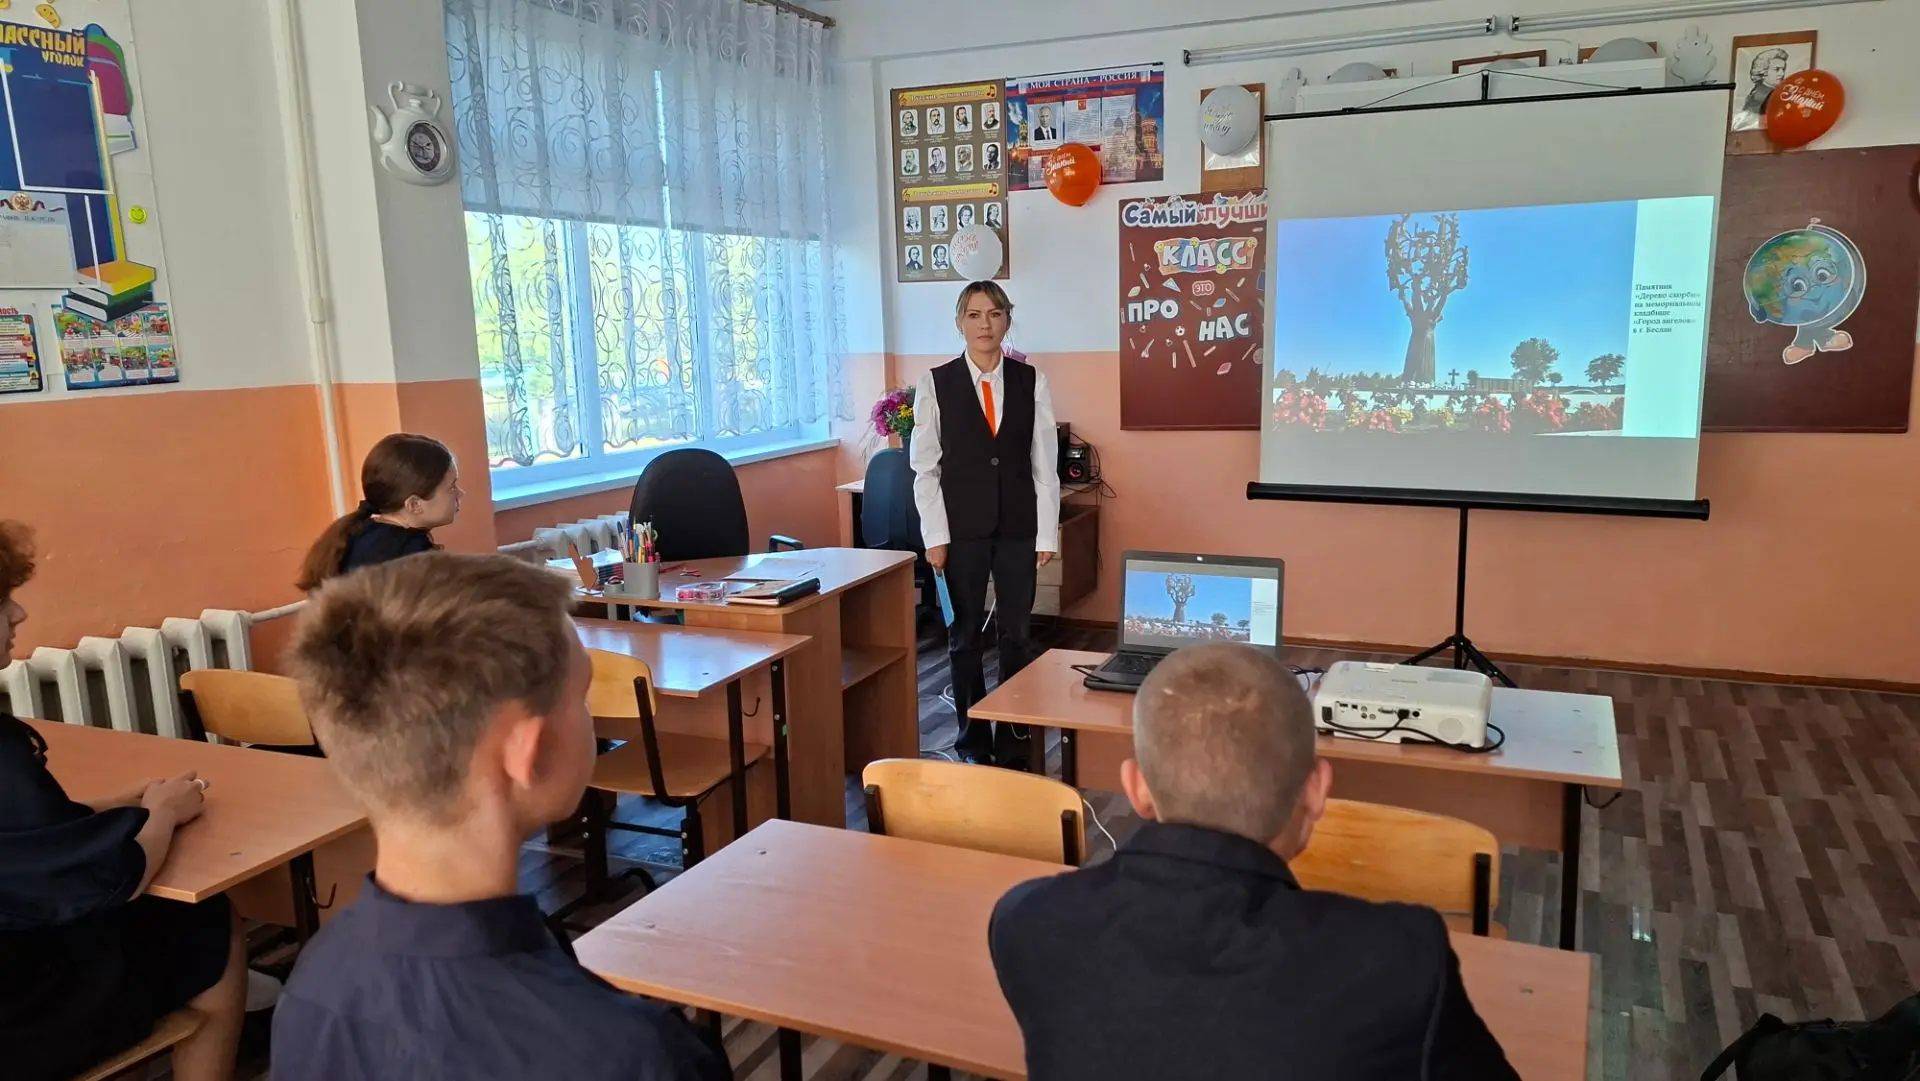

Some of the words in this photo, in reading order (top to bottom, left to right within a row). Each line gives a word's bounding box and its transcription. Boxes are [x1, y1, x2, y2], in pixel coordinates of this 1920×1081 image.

[41, 50, 84, 68] УГОЛОК
[1030, 79, 1052, 90] МОЯ
[1053, 76, 1091, 88] СТРАНА
[1099, 72, 1138, 83] РОССИЯ
[1124, 204, 1196, 225] Самый
[1162, 241, 1248, 268] КЛАСС
[1193, 282, 1212, 292] ЭТО
[1128, 299, 1179, 322] ПРО
[1198, 313, 1249, 341] НАС
